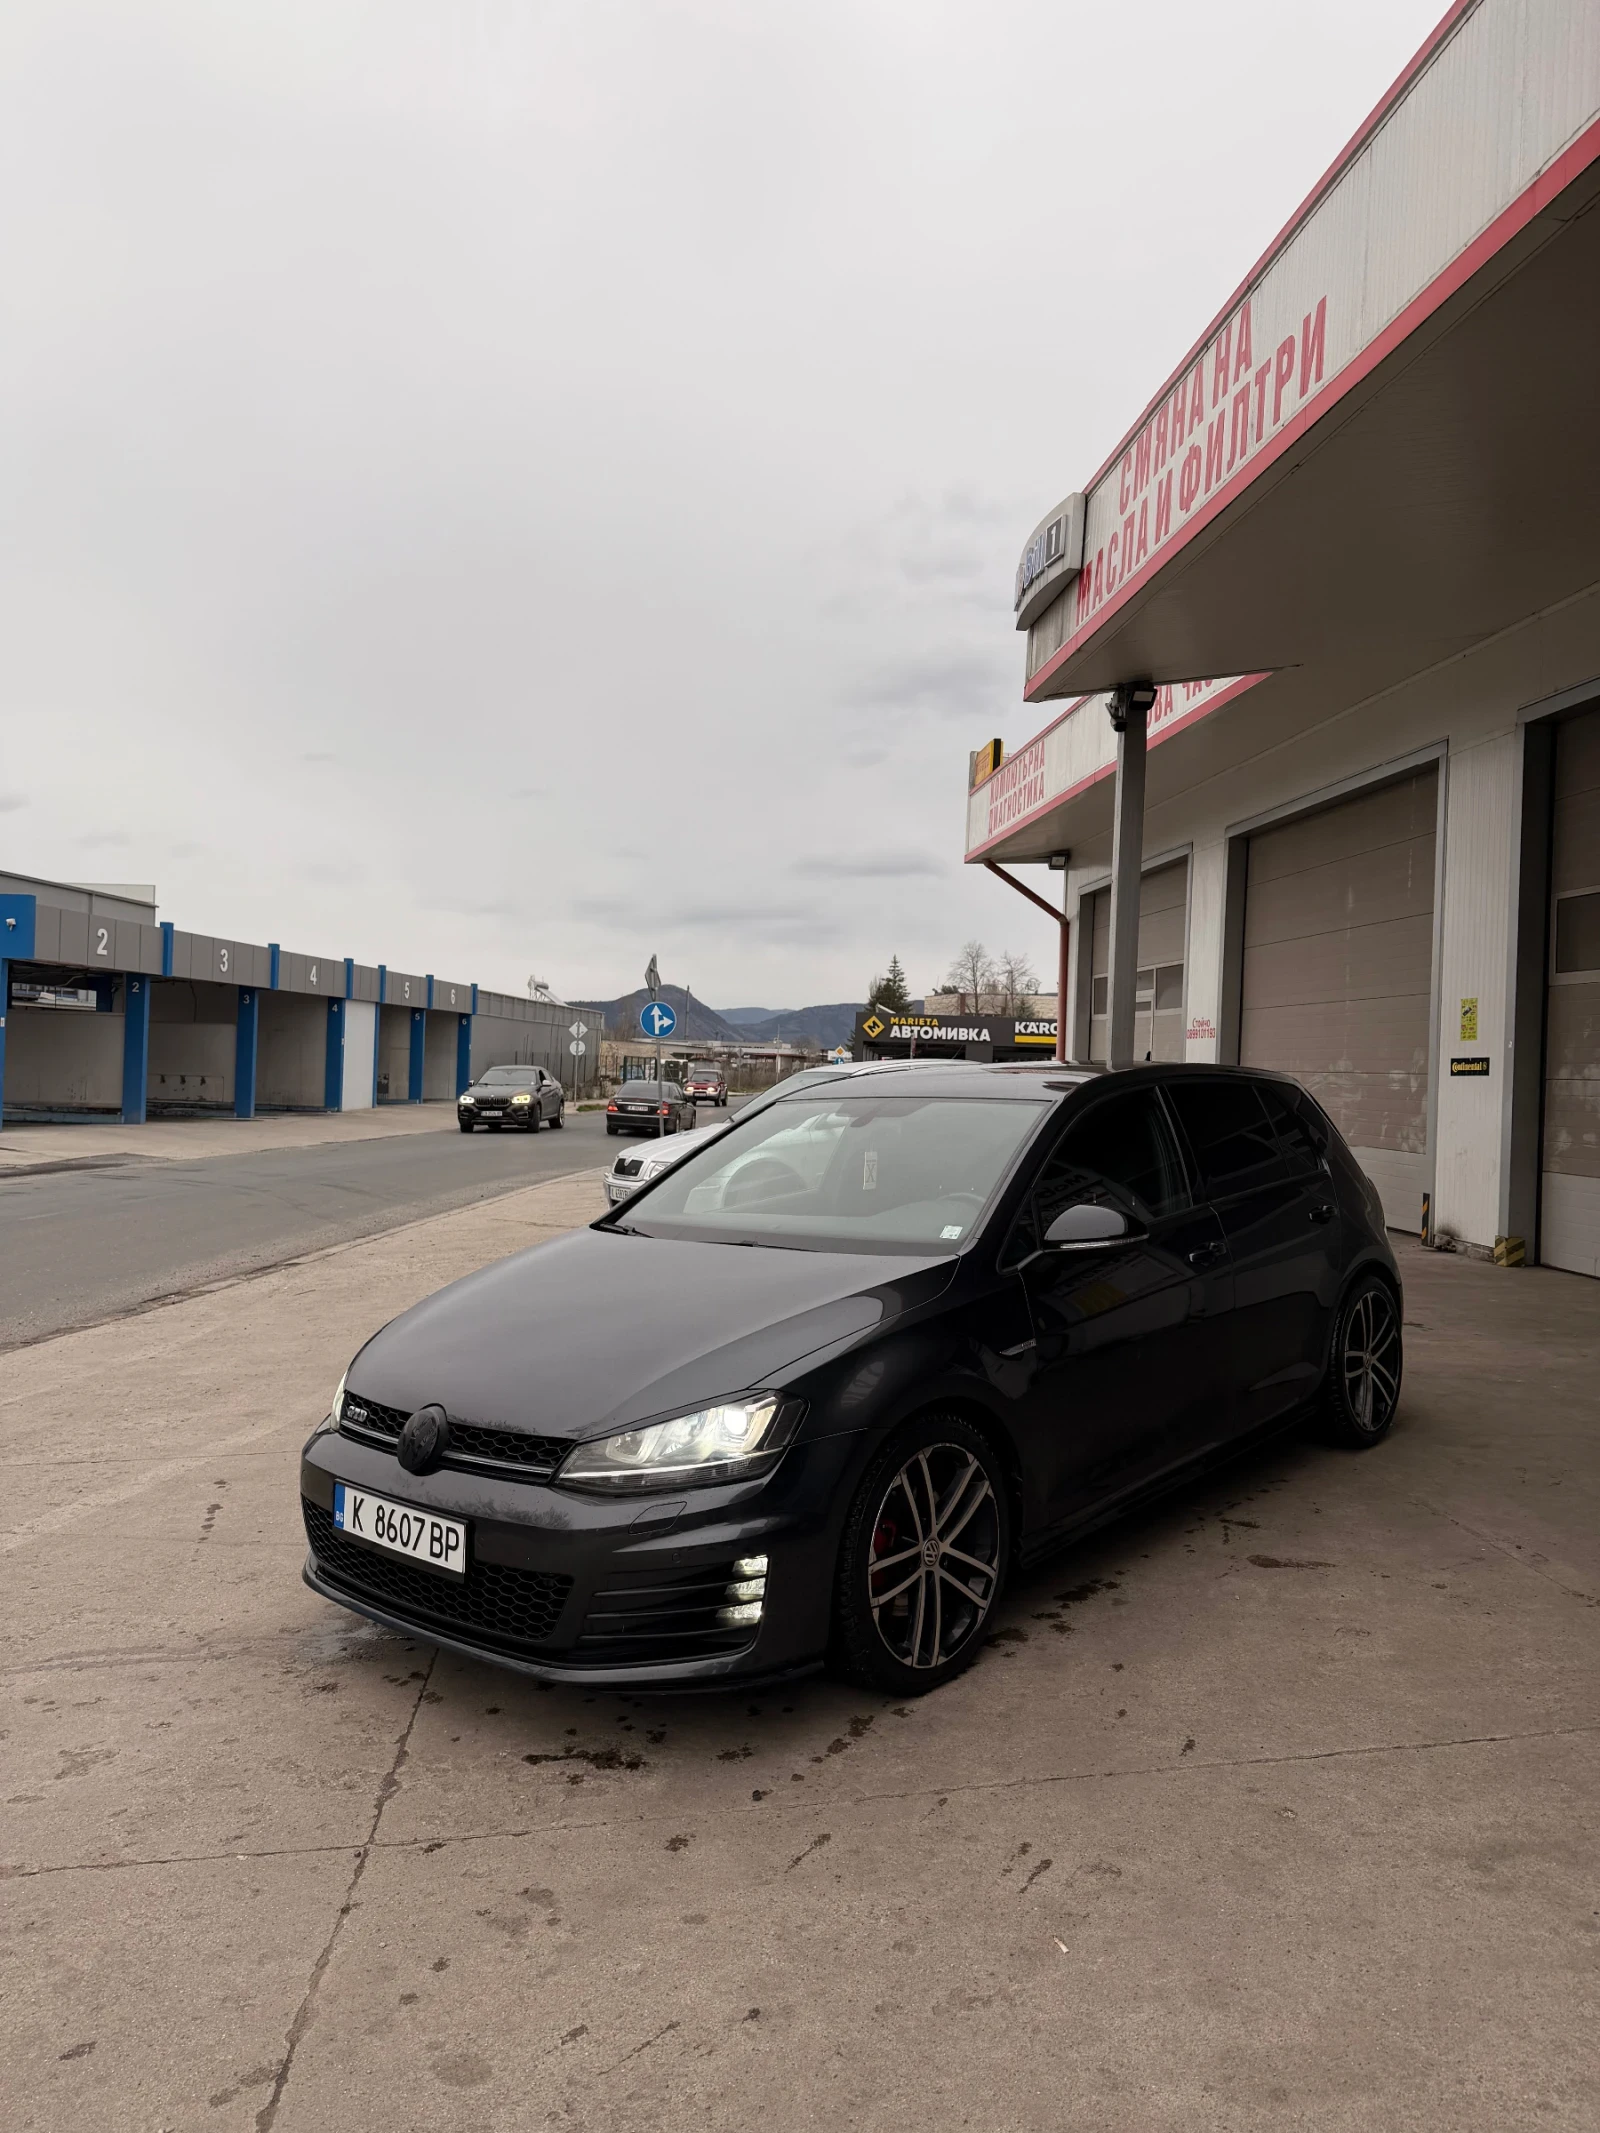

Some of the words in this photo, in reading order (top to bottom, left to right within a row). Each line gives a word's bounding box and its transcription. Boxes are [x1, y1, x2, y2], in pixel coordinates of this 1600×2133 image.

[1119, 359, 1204, 516] СМЯНА
[1213, 300, 1251, 409] НА
[1076, 496, 1148, 627] МАСЛА
[1155, 467, 1173, 546] И
[1179, 295, 1327, 514] ФИЛТРИ
[990, 740, 1045, 806] КОМПЮТЪРНА
[988, 771, 1044, 838] ДИАГНОСТИКА
[96, 928, 108, 955] 2
[220, 949, 229, 972] 3
[310, 965, 317, 985] 4
[132, 982, 140, 992] 2
[404, 982, 410, 998] 5
[243, 995, 250, 1004] 3
[450, 988, 456, 1004] 6
[332, 1003, 338, 1012] 4
[890, 1017, 939, 1026] MARIETA
[889, 1025, 991, 1042] АВТОМИВКА
[1452, 1061, 1482, 1073] Continental
[336, 1511, 344, 1521] BG
[352, 1496, 364, 1532] K
